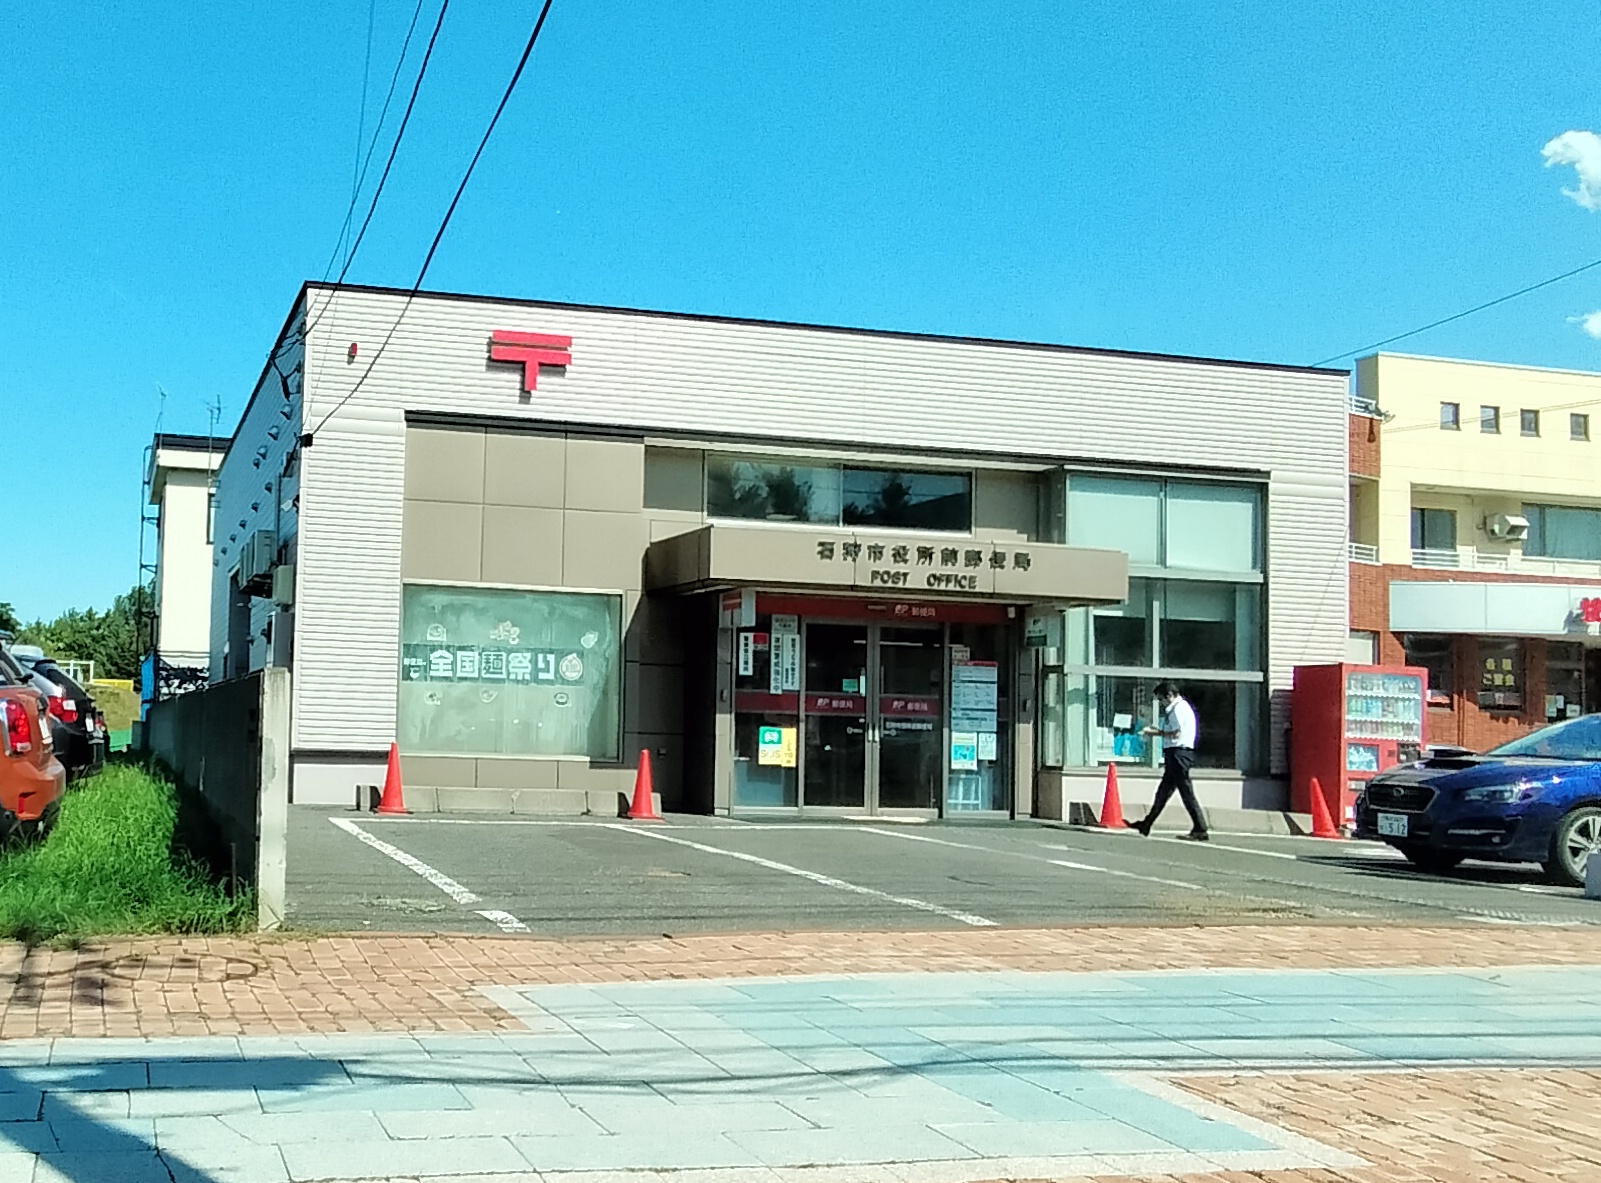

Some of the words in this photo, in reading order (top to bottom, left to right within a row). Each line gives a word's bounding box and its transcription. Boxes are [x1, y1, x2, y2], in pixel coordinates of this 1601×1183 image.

[816, 540, 1032, 572] 石狩市役所前郵便局
[870, 569, 910, 587] POST
[926, 572, 978, 590] OFFICE
[429, 649, 556, 681] 全国麺祭り
